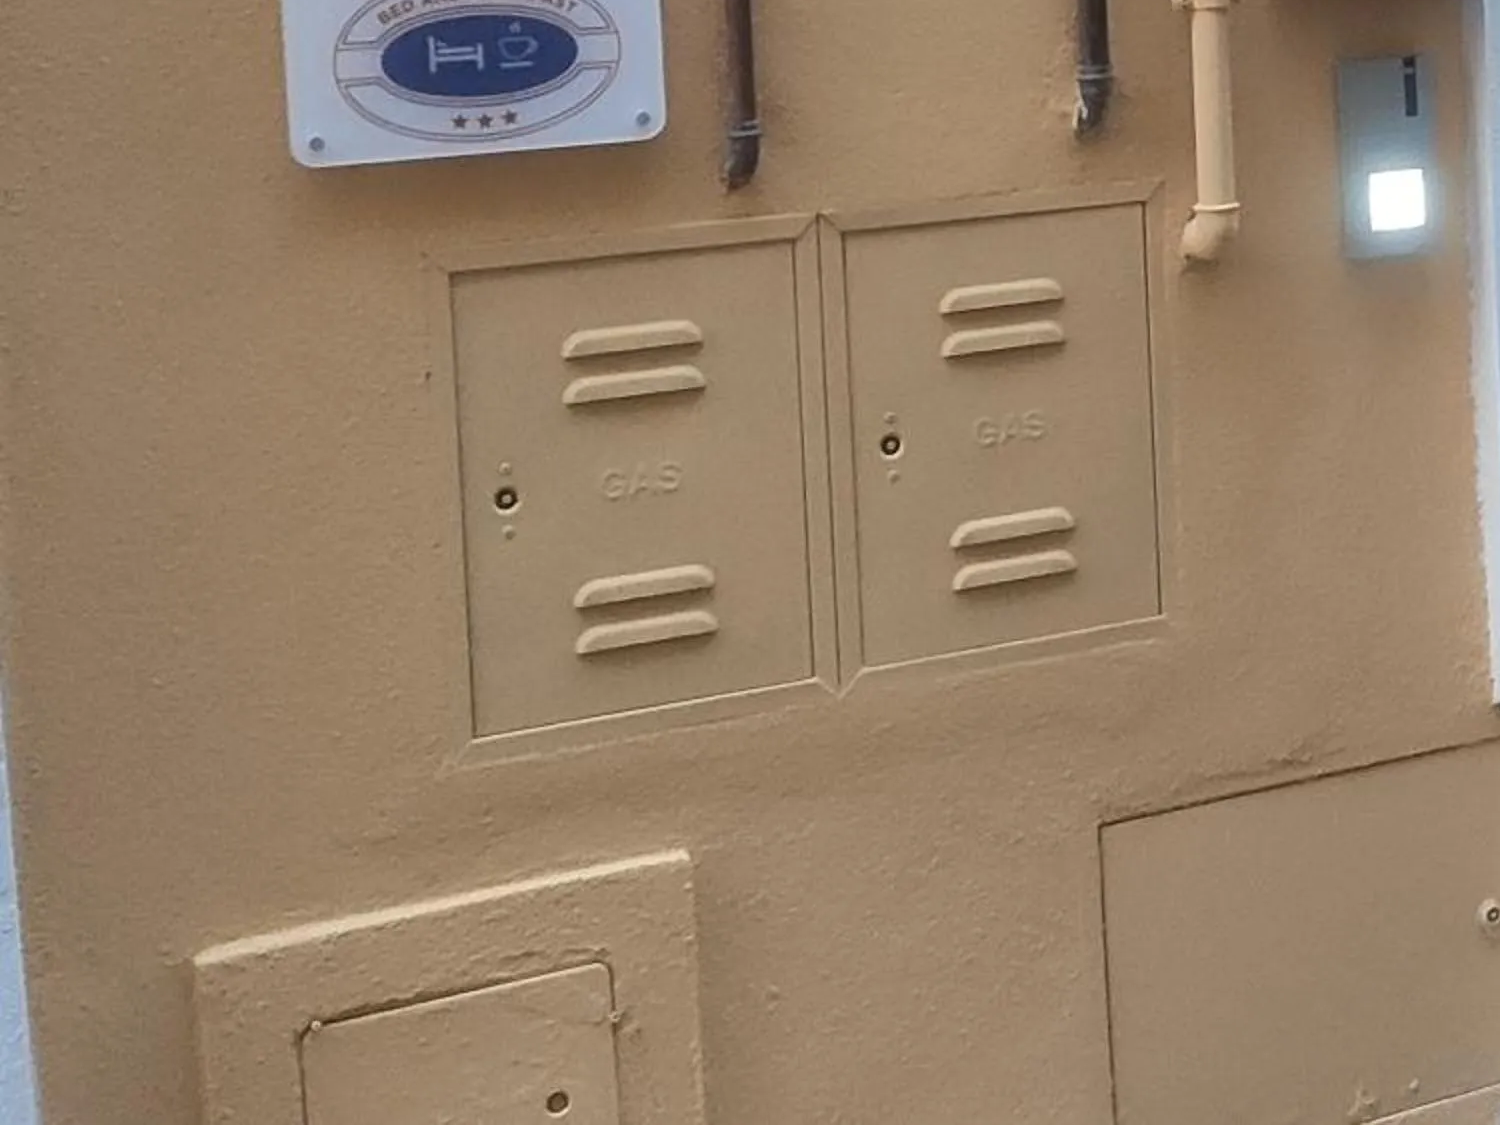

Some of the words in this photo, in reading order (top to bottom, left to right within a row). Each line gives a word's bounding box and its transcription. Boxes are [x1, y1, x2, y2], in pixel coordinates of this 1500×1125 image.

[377, 0, 415, 25] BED
[973, 410, 1048, 449] GAS
[602, 461, 683, 501] GAS
